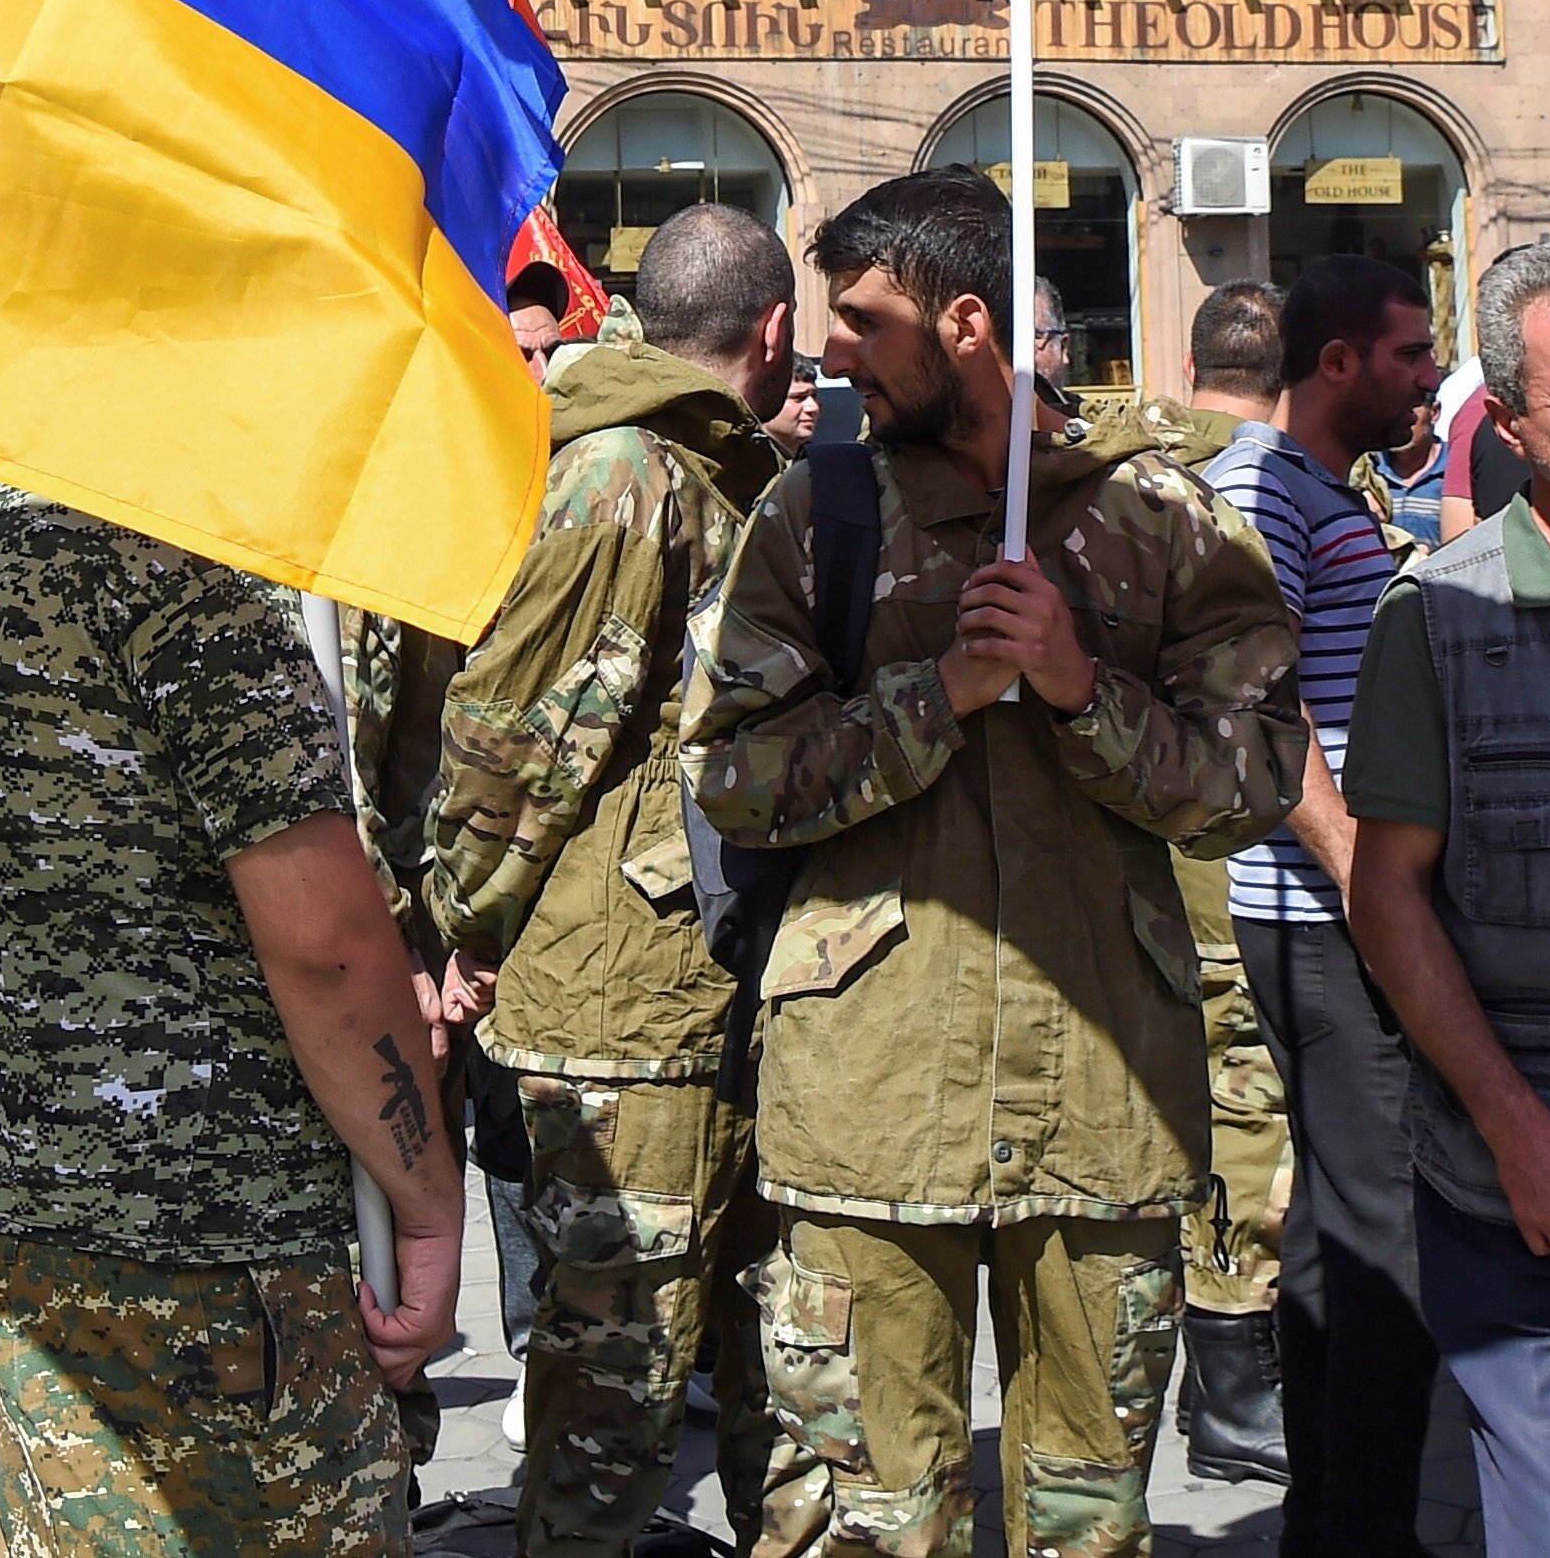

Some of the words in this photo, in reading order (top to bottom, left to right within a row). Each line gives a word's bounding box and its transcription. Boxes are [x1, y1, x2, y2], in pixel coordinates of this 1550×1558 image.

[1035, 0, 1170, 49] THE
[1174, 1, 1302, 51] OLD
[1306, 2, 1501, 51] HOUSE
[833, 30, 1011, 57] Restauran
[1341, 164, 1366, 176] THE
[1314, 186, 1344, 198] OLD
[1346, 186, 1392, 198] HOUSE
